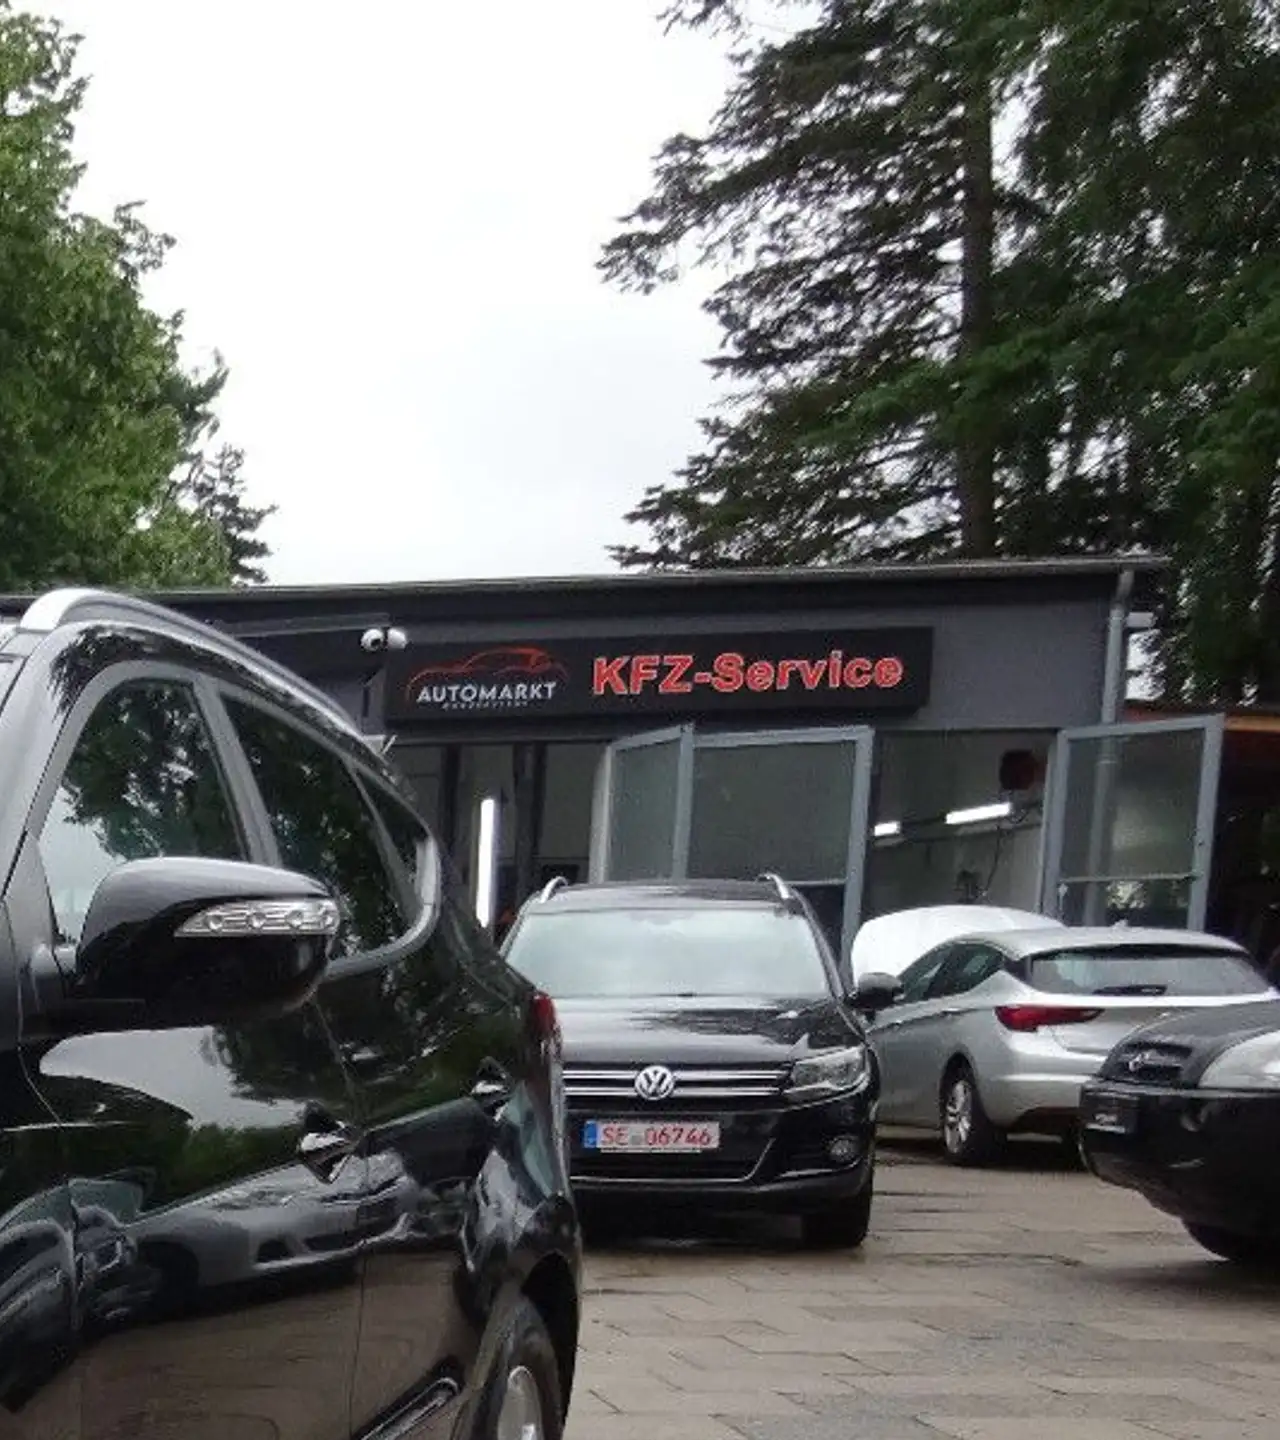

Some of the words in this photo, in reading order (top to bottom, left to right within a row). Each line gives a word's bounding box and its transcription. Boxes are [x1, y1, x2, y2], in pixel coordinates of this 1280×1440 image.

[592, 650, 904, 695] KFZ-Service
[416, 681, 557, 703] AUTOMARKT
[602, 1126, 629, 1146] SE
